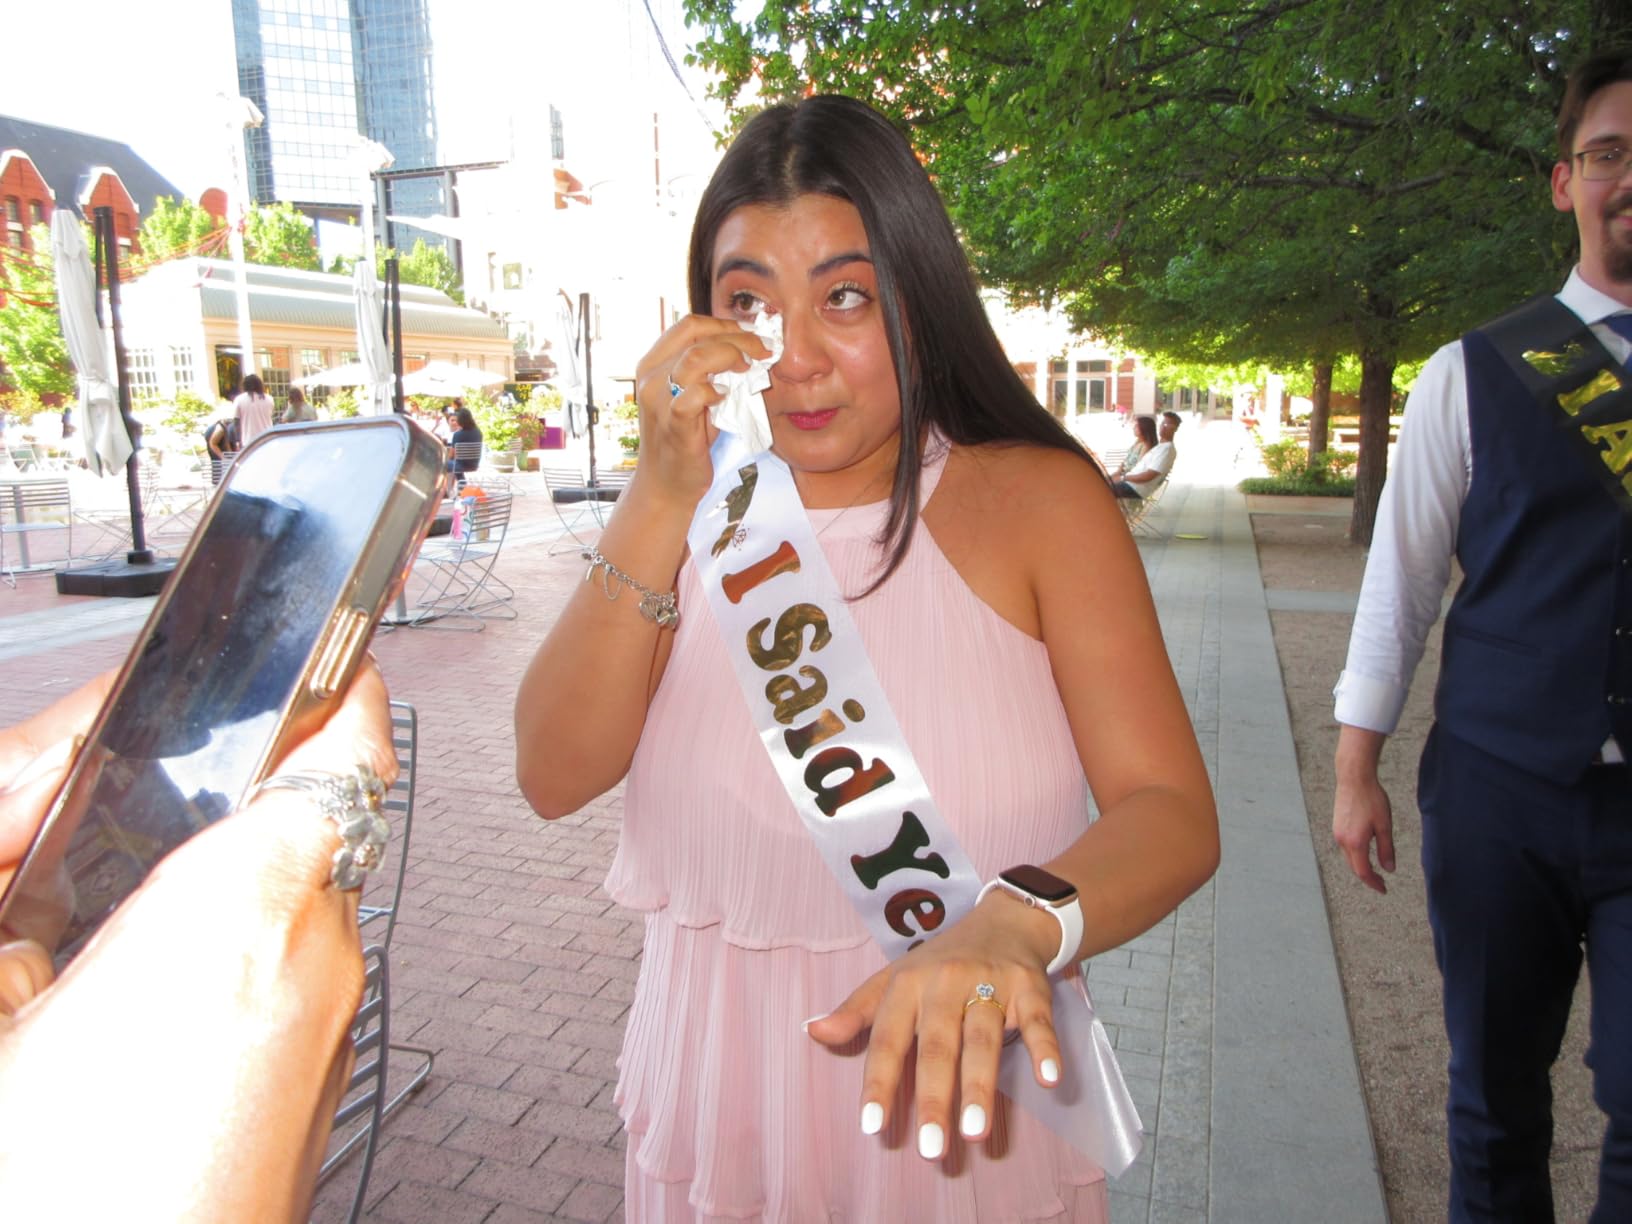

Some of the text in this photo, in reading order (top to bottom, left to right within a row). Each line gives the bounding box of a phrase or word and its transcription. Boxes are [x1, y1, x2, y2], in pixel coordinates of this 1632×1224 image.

[1581, 419, 1632, 497] A
[720, 540, 950, 952] I Said Ye
